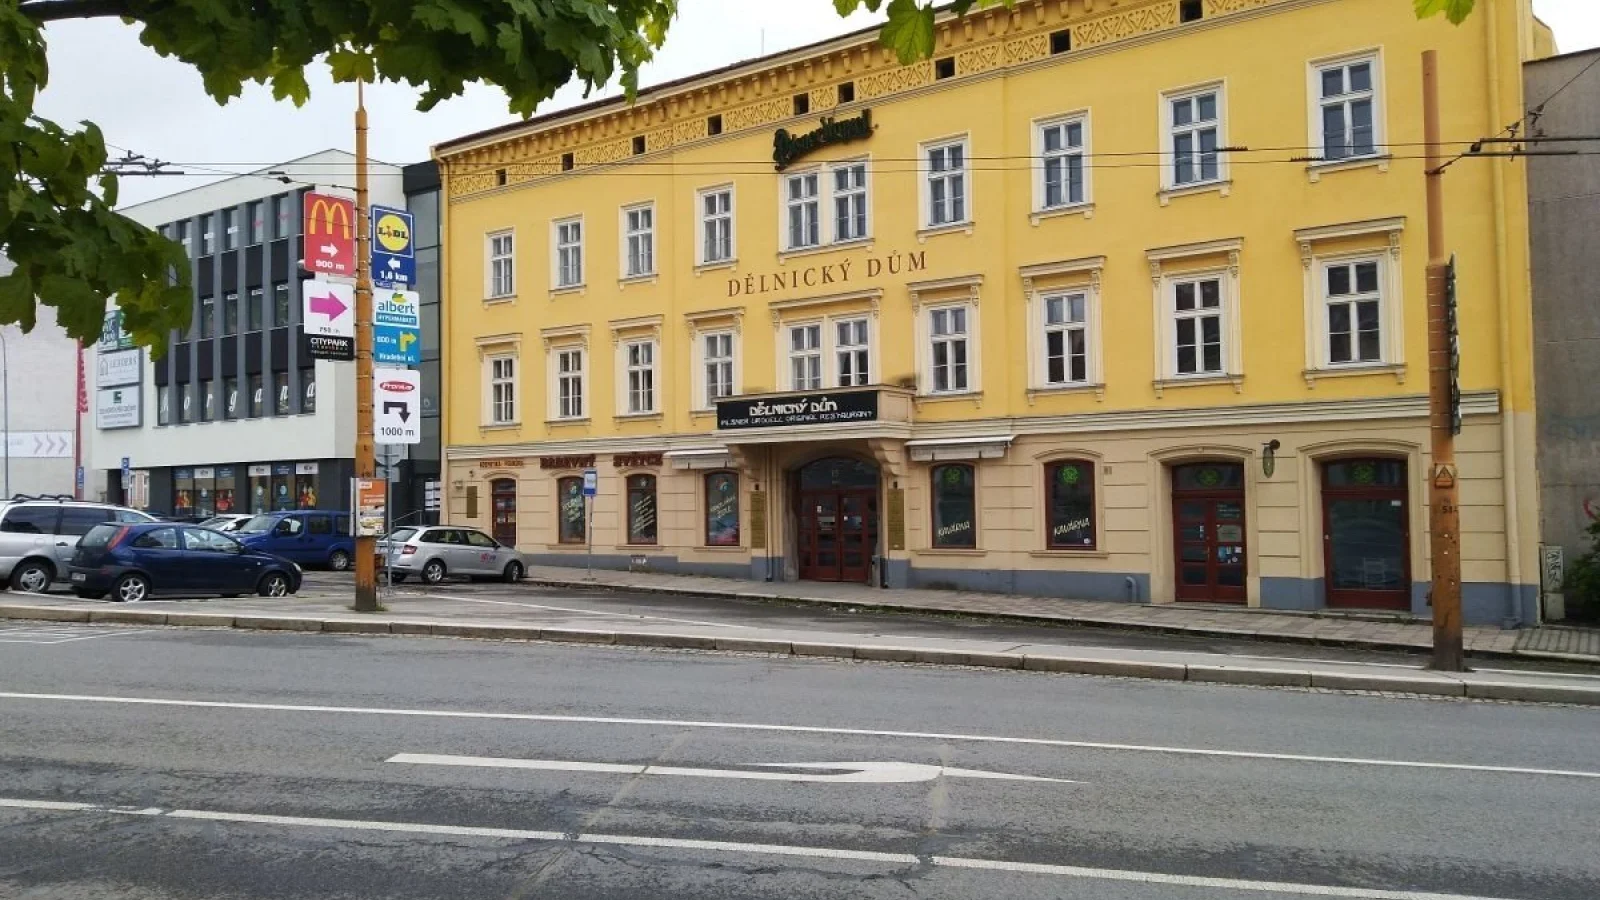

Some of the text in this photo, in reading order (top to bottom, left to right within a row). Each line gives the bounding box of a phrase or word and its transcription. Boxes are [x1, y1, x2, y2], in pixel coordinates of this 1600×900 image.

[377, 226, 409, 239] LIDL
[395, 272, 408, 281] km
[727, 250, 927, 297] DĚLNICKÝ DŮM
[378, 301, 415, 314] albert
[310, 337, 349, 347] CITYPARK
[749, 398, 808, 416] DĚLNICKÝ
[720, 418, 749, 426] PILSNER
[751, 415, 783, 425] URQUELL
[819, 410, 873, 421] RESTAURANT
[381, 427, 402, 436] 1000
